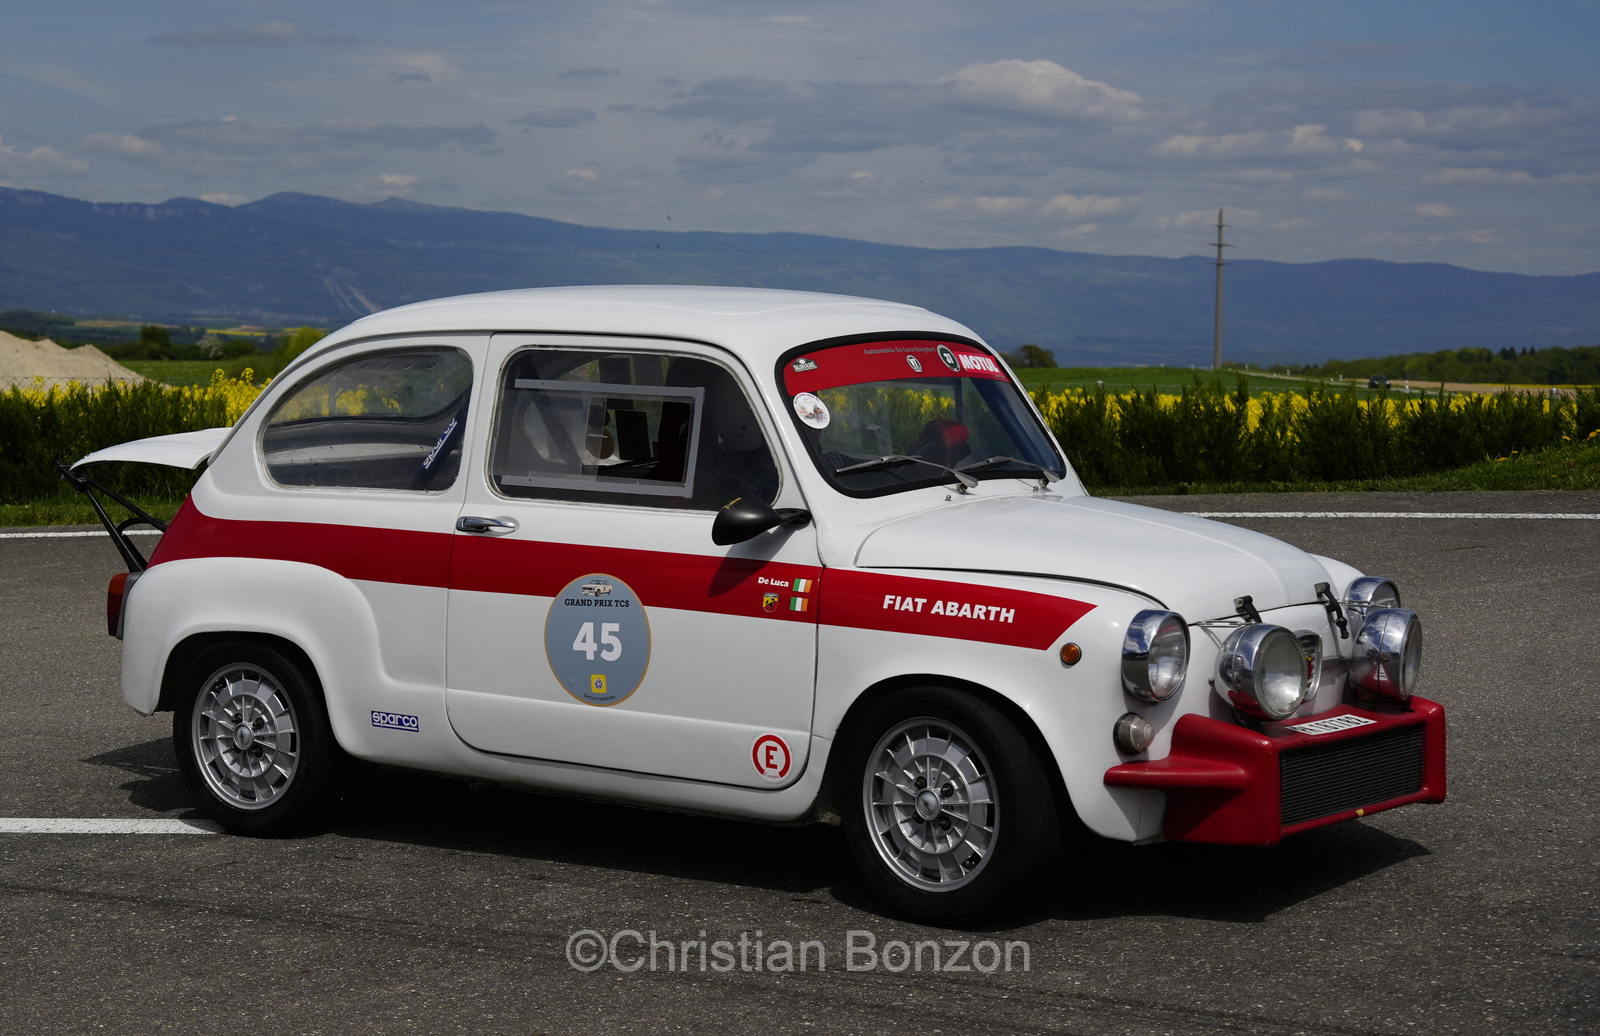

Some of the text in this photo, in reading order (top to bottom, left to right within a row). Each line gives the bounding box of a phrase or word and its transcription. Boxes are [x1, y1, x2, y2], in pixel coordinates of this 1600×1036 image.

[864, 347, 895, 355] Automobile
[958, 354, 999, 373] MOTUL
[757, 576, 789, 587] De Luca
[564, 598, 630, 608] GRAND PRIX TCS
[882, 594, 1015, 623] FIAT ABARTH
[572, 621, 622, 662] 45
[372, 711, 418, 728] sparco
[765, 745, 778, 770] E
